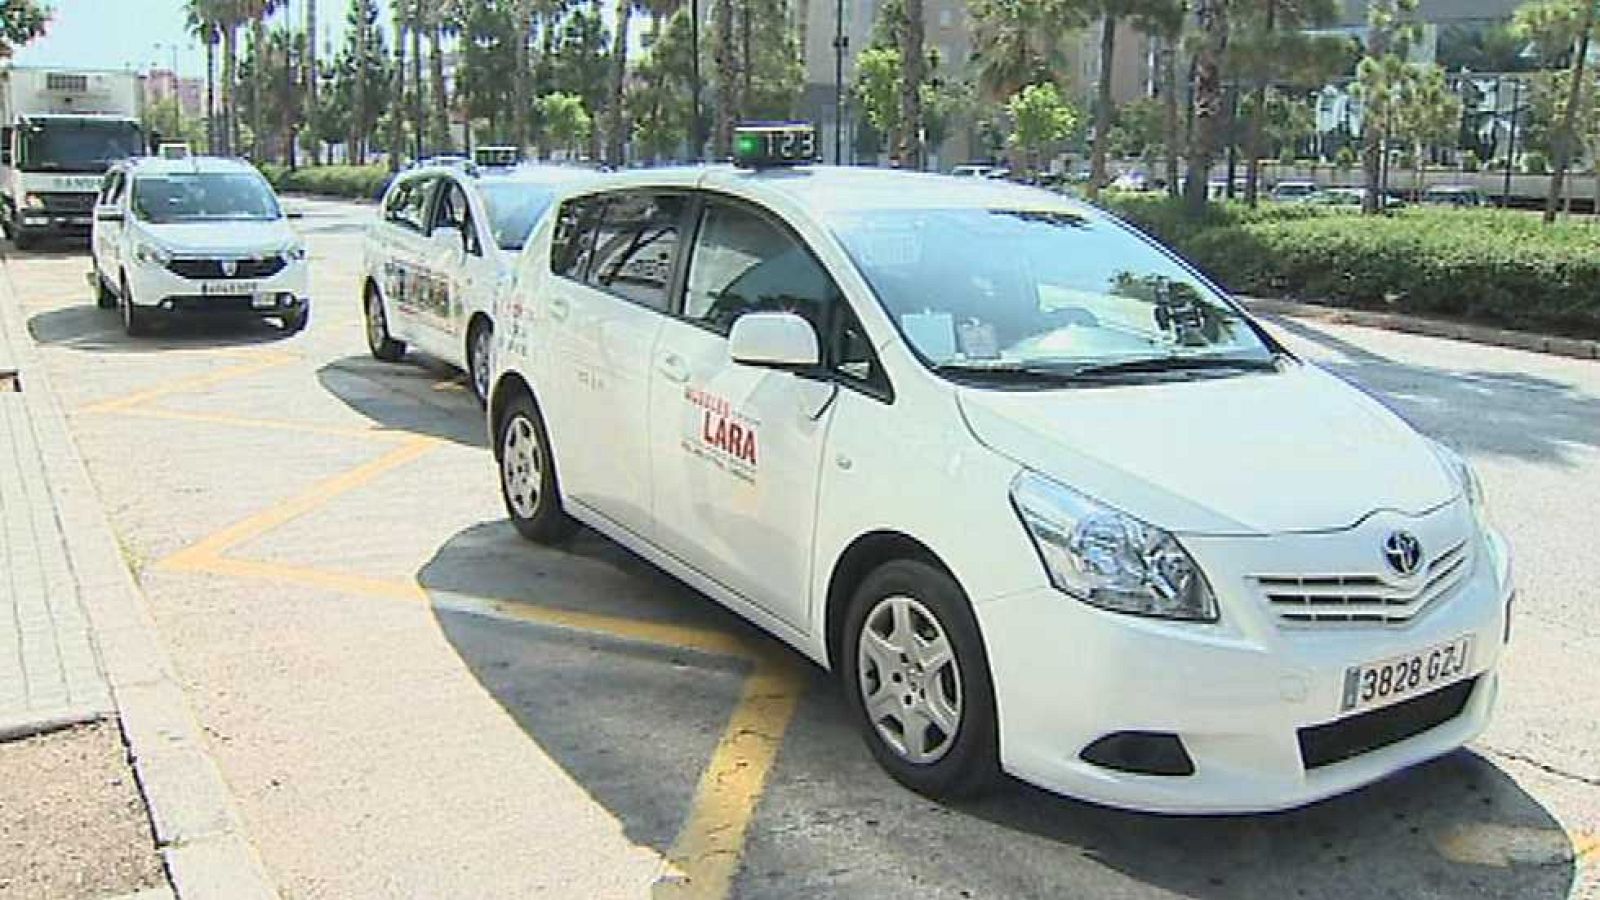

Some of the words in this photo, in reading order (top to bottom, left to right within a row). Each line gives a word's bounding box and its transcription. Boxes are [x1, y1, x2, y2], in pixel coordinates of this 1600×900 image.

[703, 409, 757, 465] LARA
[1361, 656, 1422, 701] 3828
[1427, 639, 1467, 681] GZJ
